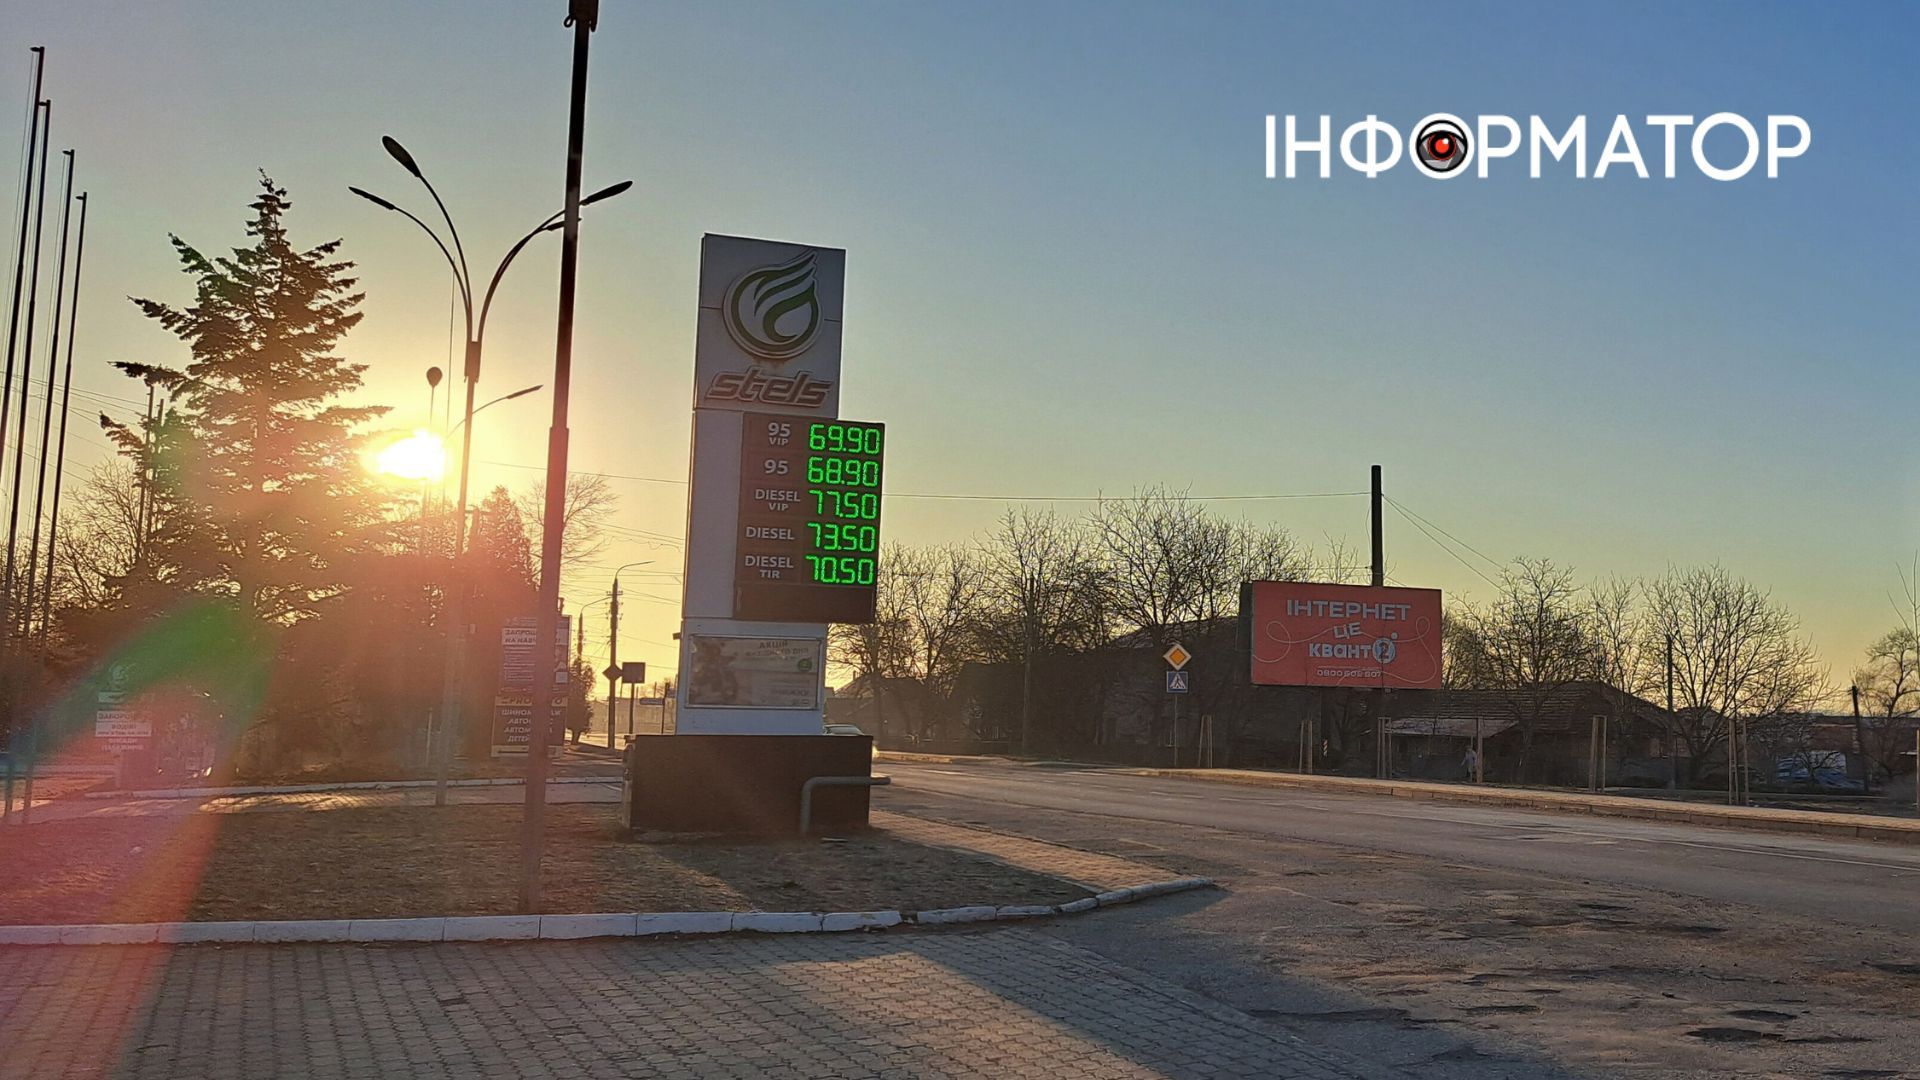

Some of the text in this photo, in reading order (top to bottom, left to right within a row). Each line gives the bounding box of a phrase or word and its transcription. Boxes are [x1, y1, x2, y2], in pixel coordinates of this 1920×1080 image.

[704, 365, 833, 408] stels
[768, 422, 791, 437] 95
[769, 438, 789, 446] VIP
[809, 423, 881, 455] 69.90
[764, 459, 788, 475] 95
[807, 456, 879, 487] 68.90
[755, 488, 800, 502] DIESEL
[769, 502, 789, 511] VIP
[808, 489, 877, 520] 77.50
[746, 526, 795, 540] DIESEL
[807, 522, 876, 552] 73.50
[745, 555, 794, 568] DIESEL
[759, 569, 780, 579] TIR
[805, 555, 874, 585] 70.50
[1286, 599, 1411, 621] ІНТЕРНЕТ
[1333, 622, 1362, 639] ЦЕ
